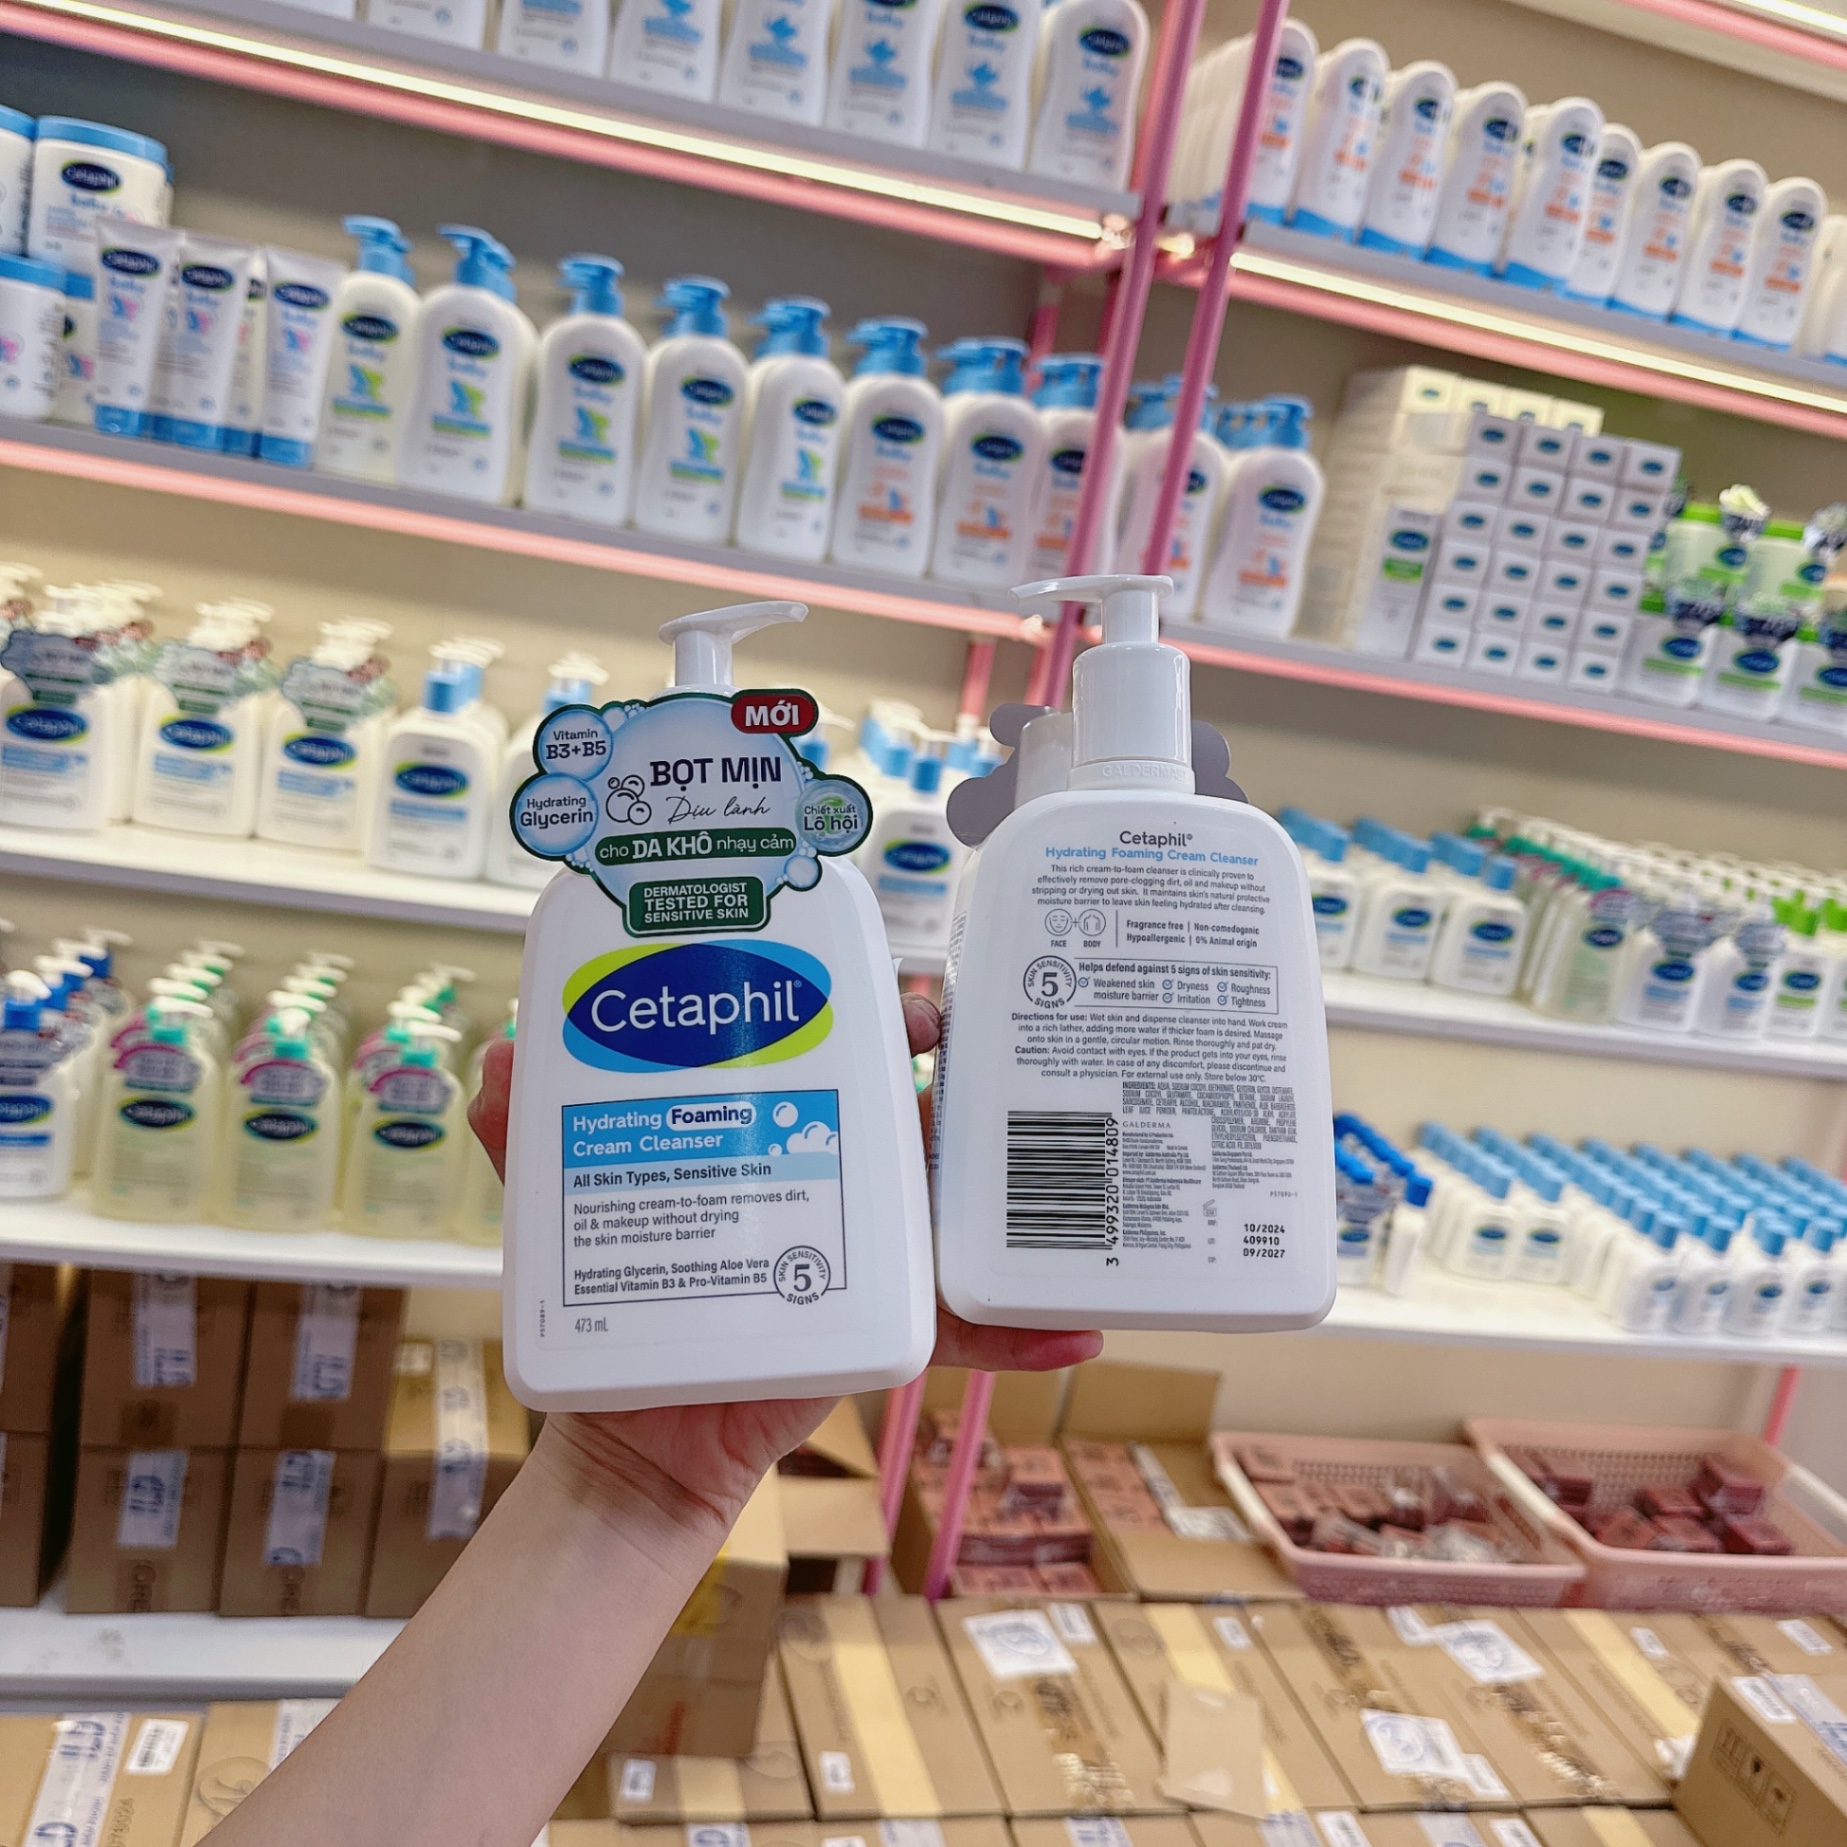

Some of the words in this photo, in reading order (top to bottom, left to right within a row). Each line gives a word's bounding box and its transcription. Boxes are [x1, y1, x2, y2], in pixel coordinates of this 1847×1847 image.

[745, 700, 800, 726] MỚI
[553, 728, 598, 740] Vitamin
[546, 740, 606, 760] B3+B5
[650, 758, 713, 791] BỌT
[722, 756, 781, 789] MỊN
[527, 796, 586, 810] Hydrating
[666, 796, 717, 824] Dịu
[724, 796, 771, 816] lành
[520, 808, 594, 830] Glycerin
[804, 816, 826, 831] Lô
[830, 814, 858, 834] hội
[600, 844, 628, 858] cho
[632, 839, 662, 859] DA
[667, 831, 712, 856] KHÔ
[717, 836, 756, 852] nhạy
[760, 832, 794, 852] cảm
[1046, 847, 1106, 860] Hydrating
[1112, 847, 1163, 862] Foaming
[1167, 849, 1206, 862] Cream
[1210, 852, 1258, 866] Cleanser
[1146, 866, 1178, 874] cleanser
[1188, 868, 1220, 879] clinically
[644, 882, 747, 898] DERMATOLOGIST
[1038, 875, 1077, 885] effectively
[1110, 877, 1165, 887] pore-clogging
[1166, 878, 1182, 887] dirt,
[1210, 881, 1238, 891] makeup
[1240, 884, 1265, 892] without
[644, 896, 708, 912] TESTED
[714, 894, 748, 908] FOR
[1032, 886, 1066, 896] stripping
[1079, 887, 1104, 896] drying
[1150, 888, 1187, 897] maintains
[1189, 890, 1208, 898] skin's
[1237, 894, 1270, 903] protective
[1112, 898, 1132, 906] leave
[1152, 898, 1178, 910] feeling
[1180, 900, 1212, 910] hydrated
[1214, 902, 1230, 910] after
[1231, 904, 1265, 915] cleansing.
[644, 910, 714, 924] SENSITIVE
[717, 908, 748, 918] SKIN
[1127, 920, 1166, 930] Fragrance
[1168, 921, 1184, 930] free
[1194, 923, 1259, 935] Non-comedogenic
[1127, 933, 1185, 944] Hypoallergenic
[1196, 936, 1208, 944] 0%
[1209, 936, 1234, 946] Animal
[1236, 939, 1257, 948] origin
[1028, 968, 1038, 988] SKIN
[1036, 960, 1072, 988] SENSITIVITY
[1079, 962, 1103, 973] Helps
[1106, 963, 1135, 972] defend
[1137, 964, 1169, 975] against
[1171, 965, 1176, 974] 5
[1178, 965, 1200, 976] signs
[1202, 966, 1210, 975] of
[1212, 967, 1228, 976] skin
[1230, 968, 1270, 980] sensitivity:
[1042, 972, 1058, 997] 5
[1094, 979, 1136, 988] Weakened
[1138, 979, 1154, 988] skin
[1178, 980, 1209, 992] Dryness
[1231, 983, 1270, 995] Roughness
[1034, 998, 1065, 1008] SIGNS
[1094, 990, 1130, 1000] moisture
[1132, 991, 1158, 1001] barrier
[1178, 994, 1210, 1004] Irritation
[1231, 996, 1266, 1008] Tightness
[574, 1112, 662, 1134] Hydrating
[671, 1105, 753, 1126] Foaming
[574, 1141, 632, 1156] Cream
[640, 1135, 723, 1151] Cleanser
[1106, 1118, 1119, 1178] 014809
[574, 1174, 590, 1188] All
[594, 1172, 622, 1186] Skin
[626, 1171, 670, 1186] Types,
[674, 1166, 737, 1180] Sensitive
[742, 1163, 771, 1176] Skin
[574, 1200, 635, 1215] Nourishing
[639, 1195, 727, 1210] cream-to-foam
[731, 1193, 782, 1204] removes
[785, 1190, 809, 1202] dirt,
[574, 1219, 587, 1231] oil
[590, 1218, 599, 1230] &
[603, 1216, 649, 1229] makeup
[652, 1212, 697, 1225] without
[700, 1210, 739, 1224] drying
[1106, 1184, 1119, 1245] 499320
[1244, 1224, 1285, 1233] 10/2024
[574, 1235, 592, 1247] the
[595, 1233, 617, 1246] skin
[621, 1231, 672, 1244] moisture
[676, 1228, 716, 1240] barrier
[1244, 1236, 1279, 1245] 409910
[1106, 1257, 1119, 1266] 3
[1243, 1248, 1285, 1258] 09/2027
[574, 1268, 621, 1281] Hydrating
[624, 1264, 668, 1278] Glycerin,
[671, 1262, 717, 1274] Soothing
[720, 1260, 743, 1270] Aloe
[746, 1259, 769, 1268] Vera
[778, 1261, 788, 1282] SKIN
[787, 1251, 826, 1280] SENSITIVITY
[575, 1282, 618, 1295] Essential
[620, 1280, 659, 1292] Vitamin
[662, 1278, 675, 1289] B3
[678, 1278, 686, 1288] &
[690, 1274, 750, 1287] Pro-Vitamin
[753, 1273, 767, 1283] B5
[794, 1264, 812, 1292] 5
[786, 1292, 819, 1305] SIGNS
[575, 1318, 592, 1332] 473
[594, 1317, 608, 1332] mL
